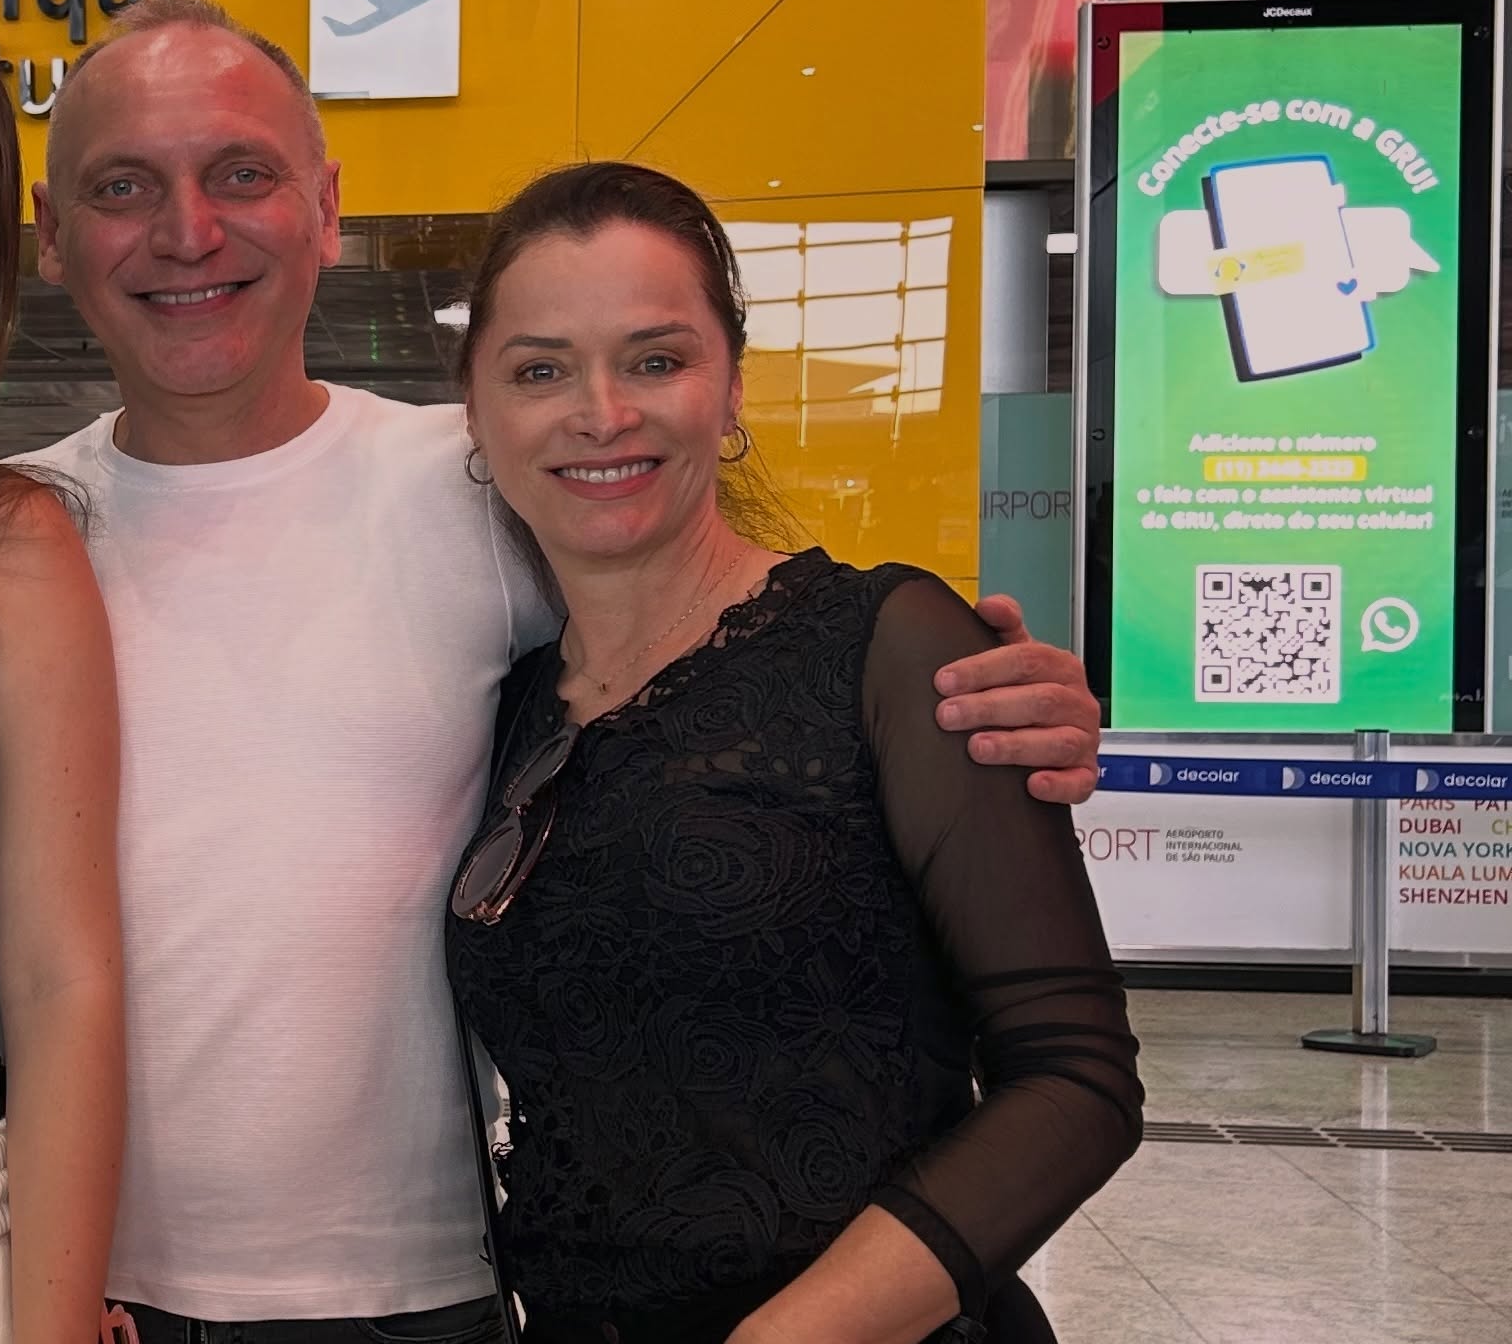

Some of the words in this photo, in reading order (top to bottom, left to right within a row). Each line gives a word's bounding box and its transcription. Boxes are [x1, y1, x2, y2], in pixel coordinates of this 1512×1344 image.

[1263, 7, 1313, 17] JCDecaux
[1137, 100, 1280, 197] Conecte-se
[1285, 98, 1352, 130] com
[1352, 117, 1376, 141] a
[1374, 129, 1439, 194] GRU!
[1195, 488, 1240, 504] com
[1258, 485, 1362, 504] assistente
[1364, 484, 1433, 504] virtual
[978, 491, 1072, 520] IRPOR
[1317, 513, 1354, 529] seu
[1356, 510, 1433, 529] celular!
[1177, 768, 1240, 782] decolar
[1309, 771, 1373, 786] decolar
[1444, 773, 1508, 788] decolar
[1399, 798, 1456, 811] PARIS
[1399, 818, 1462, 834] DUBAI
[1165, 829, 1224, 839] AEROPORTO
[1165, 841, 1243, 851] INTERNACIONAL
[1399, 842, 1457, 857] NOVA
[1165, 852, 1179, 862] DE
[1203, 853, 1236, 863] PAULO
[1399, 865, 1465, 881] KUALA
[1471, 865, 1512, 881] LUM
[1399, 888, 1508, 905] SHENZHEN
